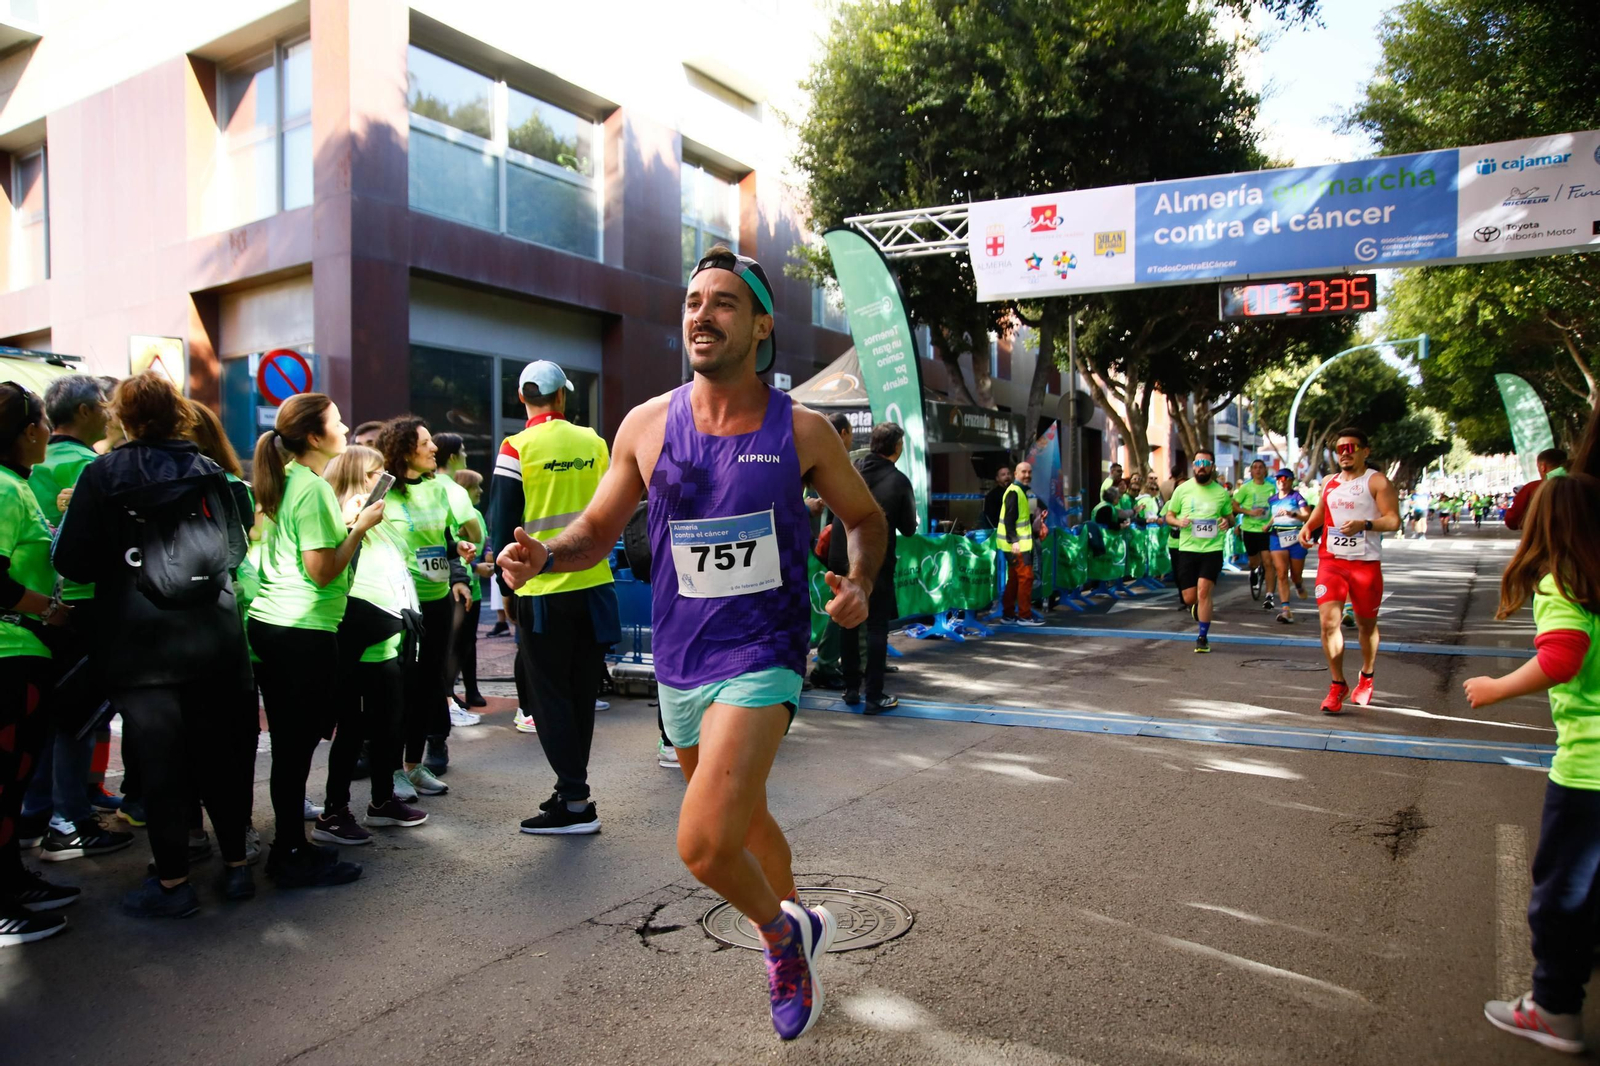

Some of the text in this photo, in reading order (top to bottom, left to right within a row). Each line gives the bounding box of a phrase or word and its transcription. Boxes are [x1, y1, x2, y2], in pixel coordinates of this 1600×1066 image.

[1501, 153, 1572, 172] cajamar
[1154, 167, 1437, 216] Almería en marcha
[1502, 197, 1549, 207] MICHELIN
[1154, 204, 1397, 245] contra el cáncer
[1506, 222, 1540, 232] Toyota
[1506, 228, 1577, 242] Alborán Motor
[738, 454, 780, 464] KIPRUN
[1196, 524, 1213, 532] 545
[704, 530, 729, 538] cáncer
[1333, 536, 1357, 547] 225
[690, 540, 757, 572] 757
